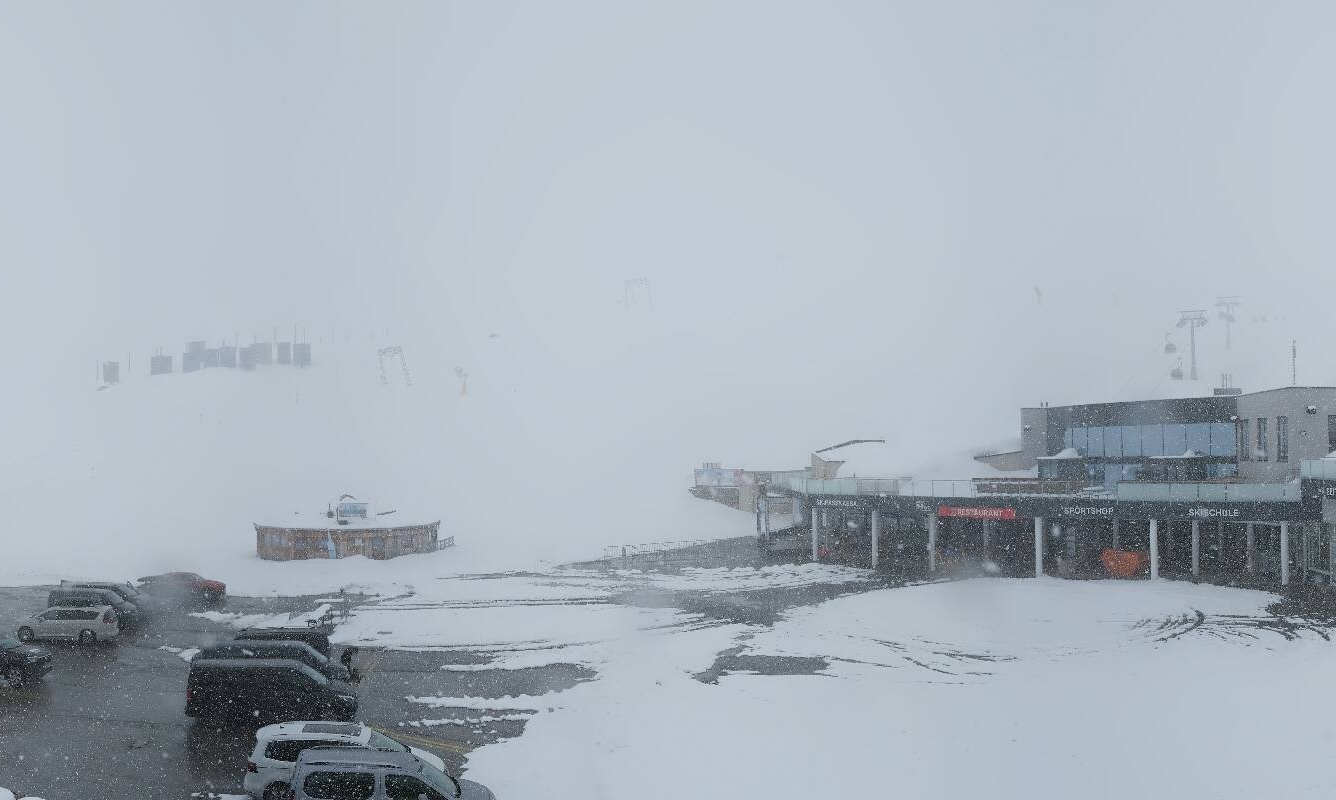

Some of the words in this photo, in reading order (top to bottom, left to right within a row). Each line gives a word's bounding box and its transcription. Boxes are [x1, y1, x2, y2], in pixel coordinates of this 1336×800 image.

[957, 507, 1003, 517] RESTAURANT
[1064, 507, 1114, 515] SPORTSHOP
[1189, 508, 1239, 517] SKISCHULE
